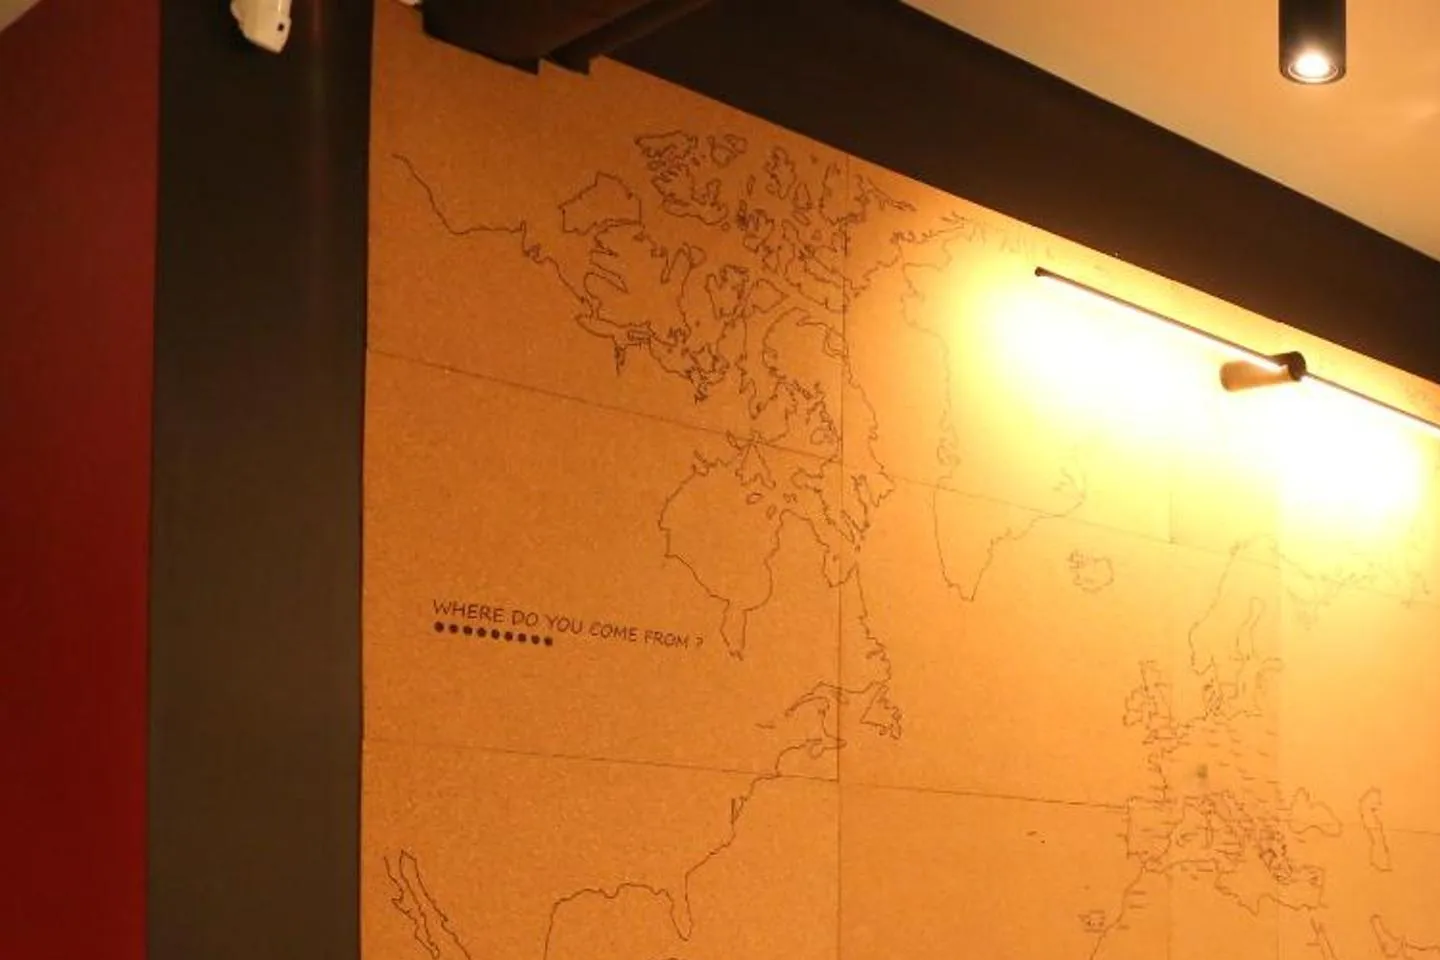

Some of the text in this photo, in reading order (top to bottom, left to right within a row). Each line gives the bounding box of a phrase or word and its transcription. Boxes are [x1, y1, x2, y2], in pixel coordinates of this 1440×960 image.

[433, 600, 504, 623] WHERE
[511, 610, 539, 627] DO
[546, 614, 583, 635] YOU
[589, 621, 638, 642] COME
[644, 629, 689, 648] FROM
